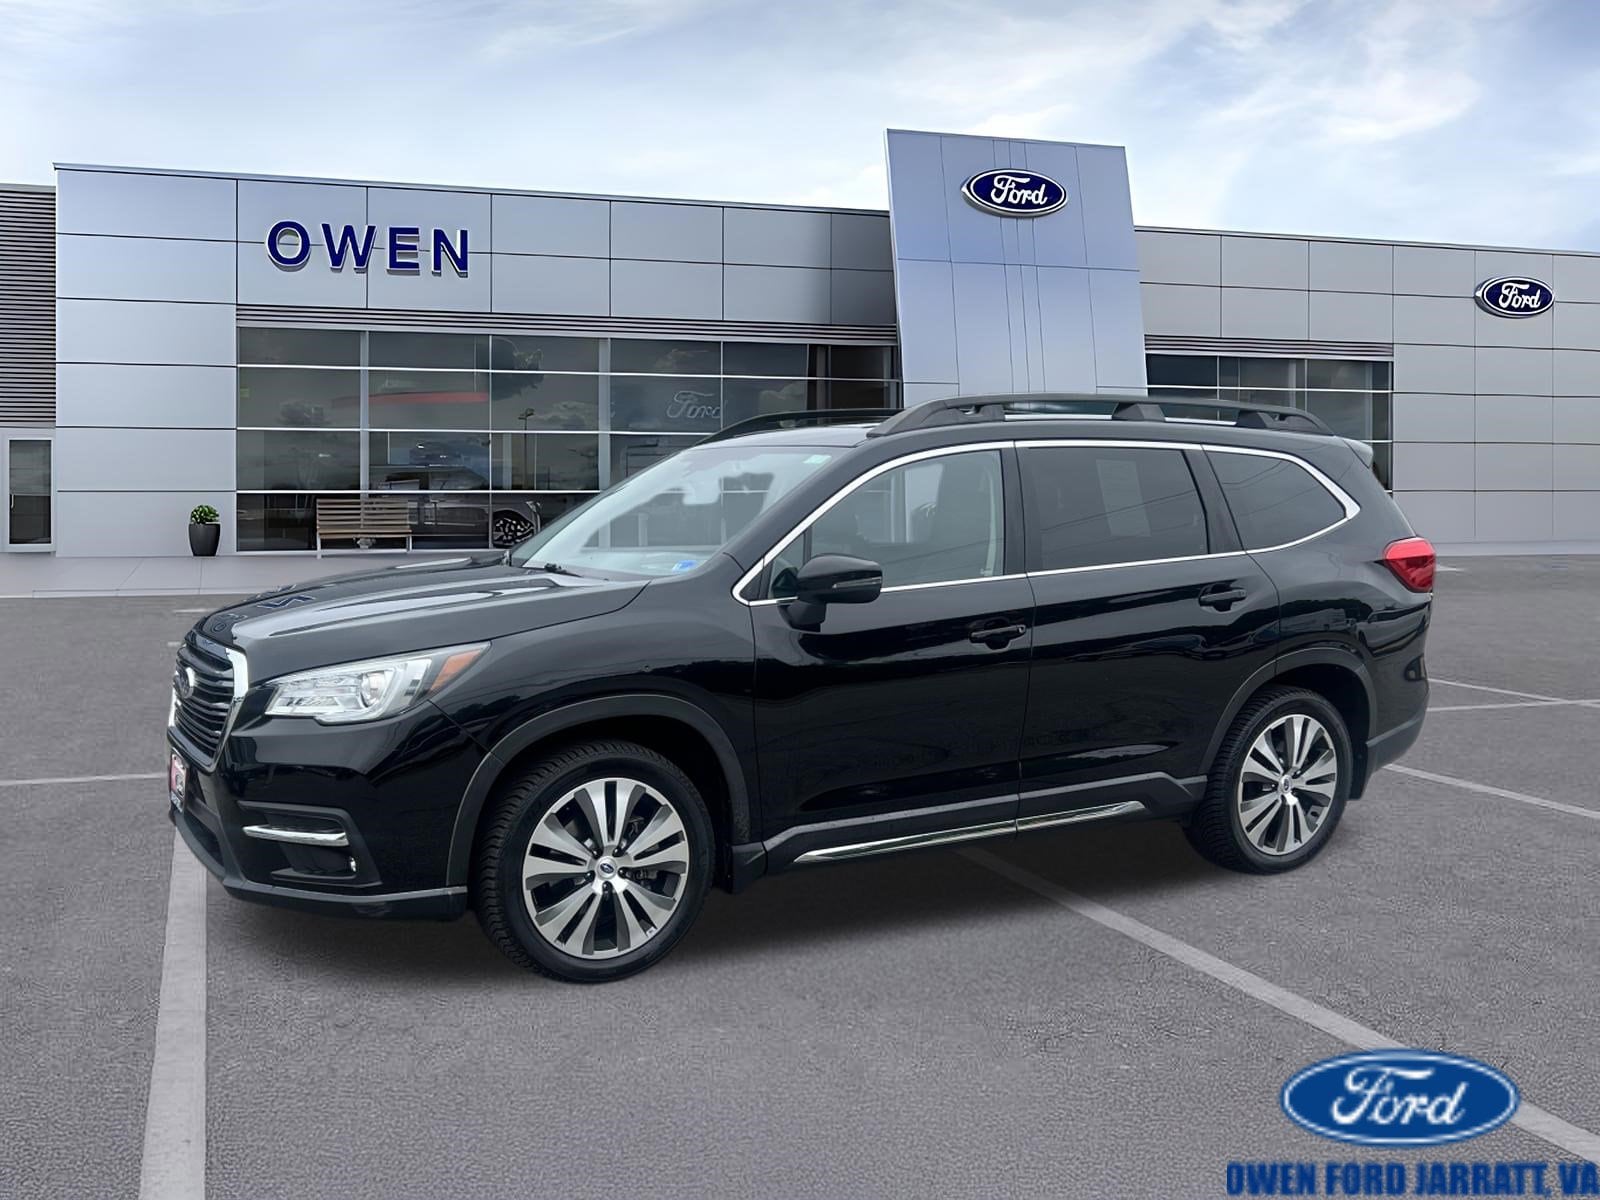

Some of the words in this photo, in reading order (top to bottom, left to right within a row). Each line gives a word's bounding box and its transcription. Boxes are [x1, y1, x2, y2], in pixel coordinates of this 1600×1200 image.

[990, 175, 1048, 205] Ford
[266, 220, 469, 276] OWEN
[1498, 282, 1541, 308] Ford
